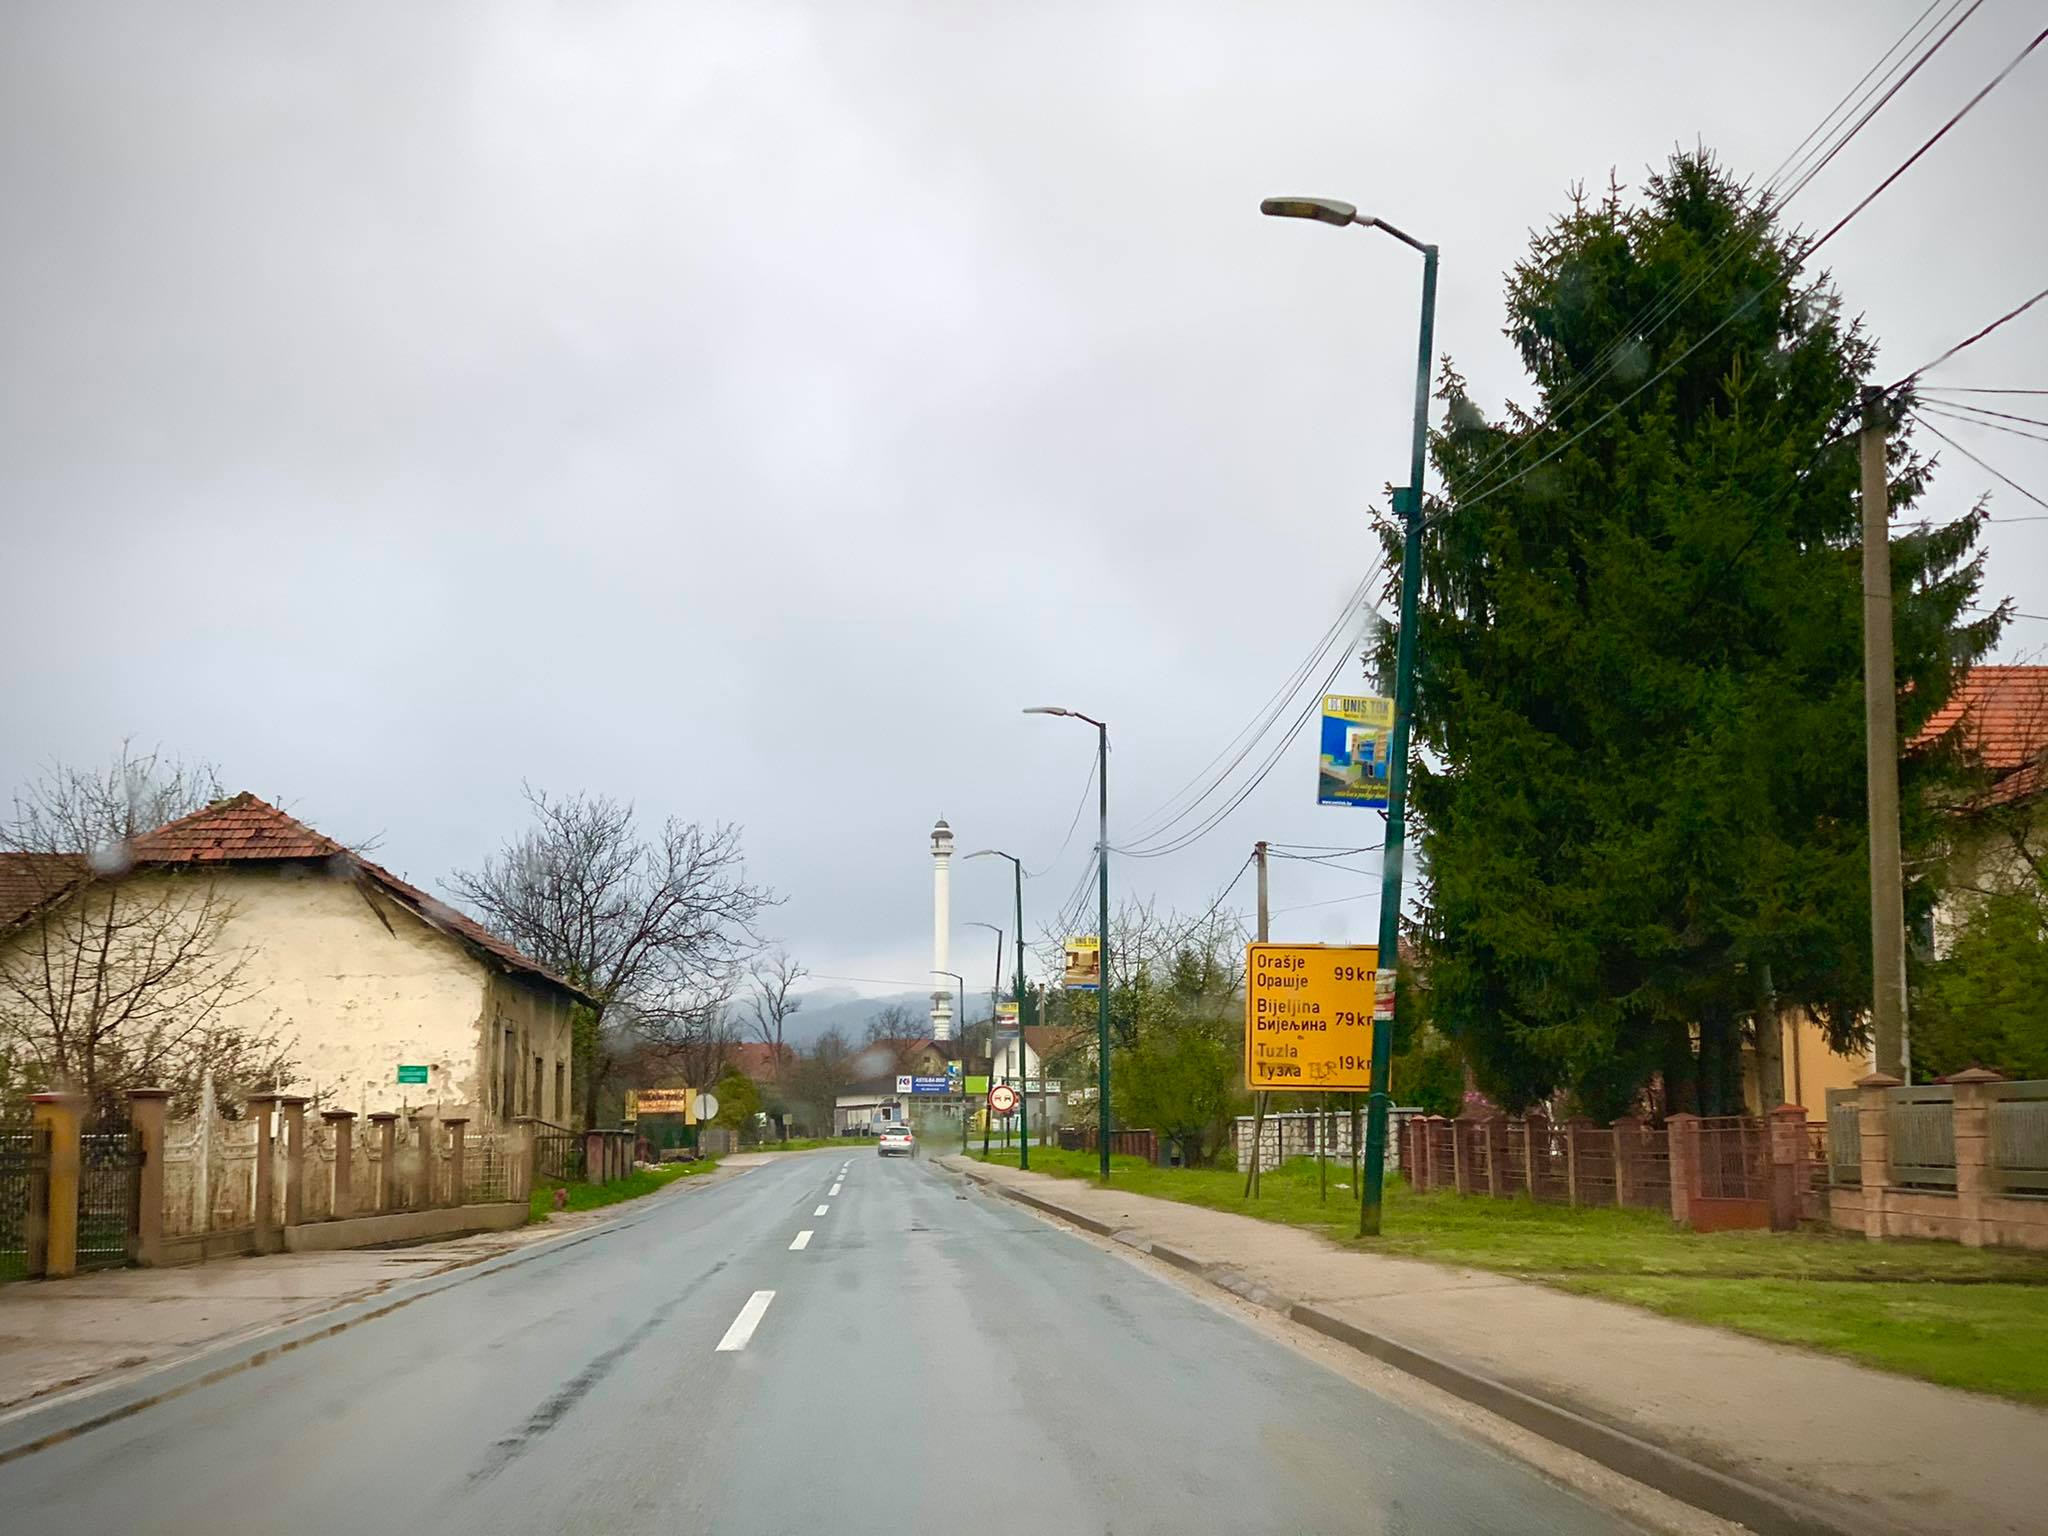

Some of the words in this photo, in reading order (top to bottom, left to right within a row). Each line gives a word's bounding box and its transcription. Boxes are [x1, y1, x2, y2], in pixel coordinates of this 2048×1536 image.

[1343, 698, 1367, 713] UNIS
[1257, 954, 1305, 972] Orašje
[1257, 973, 1309, 990] Орашје
[1334, 966, 1354, 981] 99
[1257, 999, 1320, 1016] Bijeljina
[1257, 1016, 1327, 1034] Бијељина
[1335, 1012, 1355, 1026] 79
[1257, 1043, 1298, 1058] Tuzla
[1339, 1055, 1355, 1070] 19
[1357, 1055, 1372, 1070] k
[1257, 1062, 1302, 1080] Тузла
